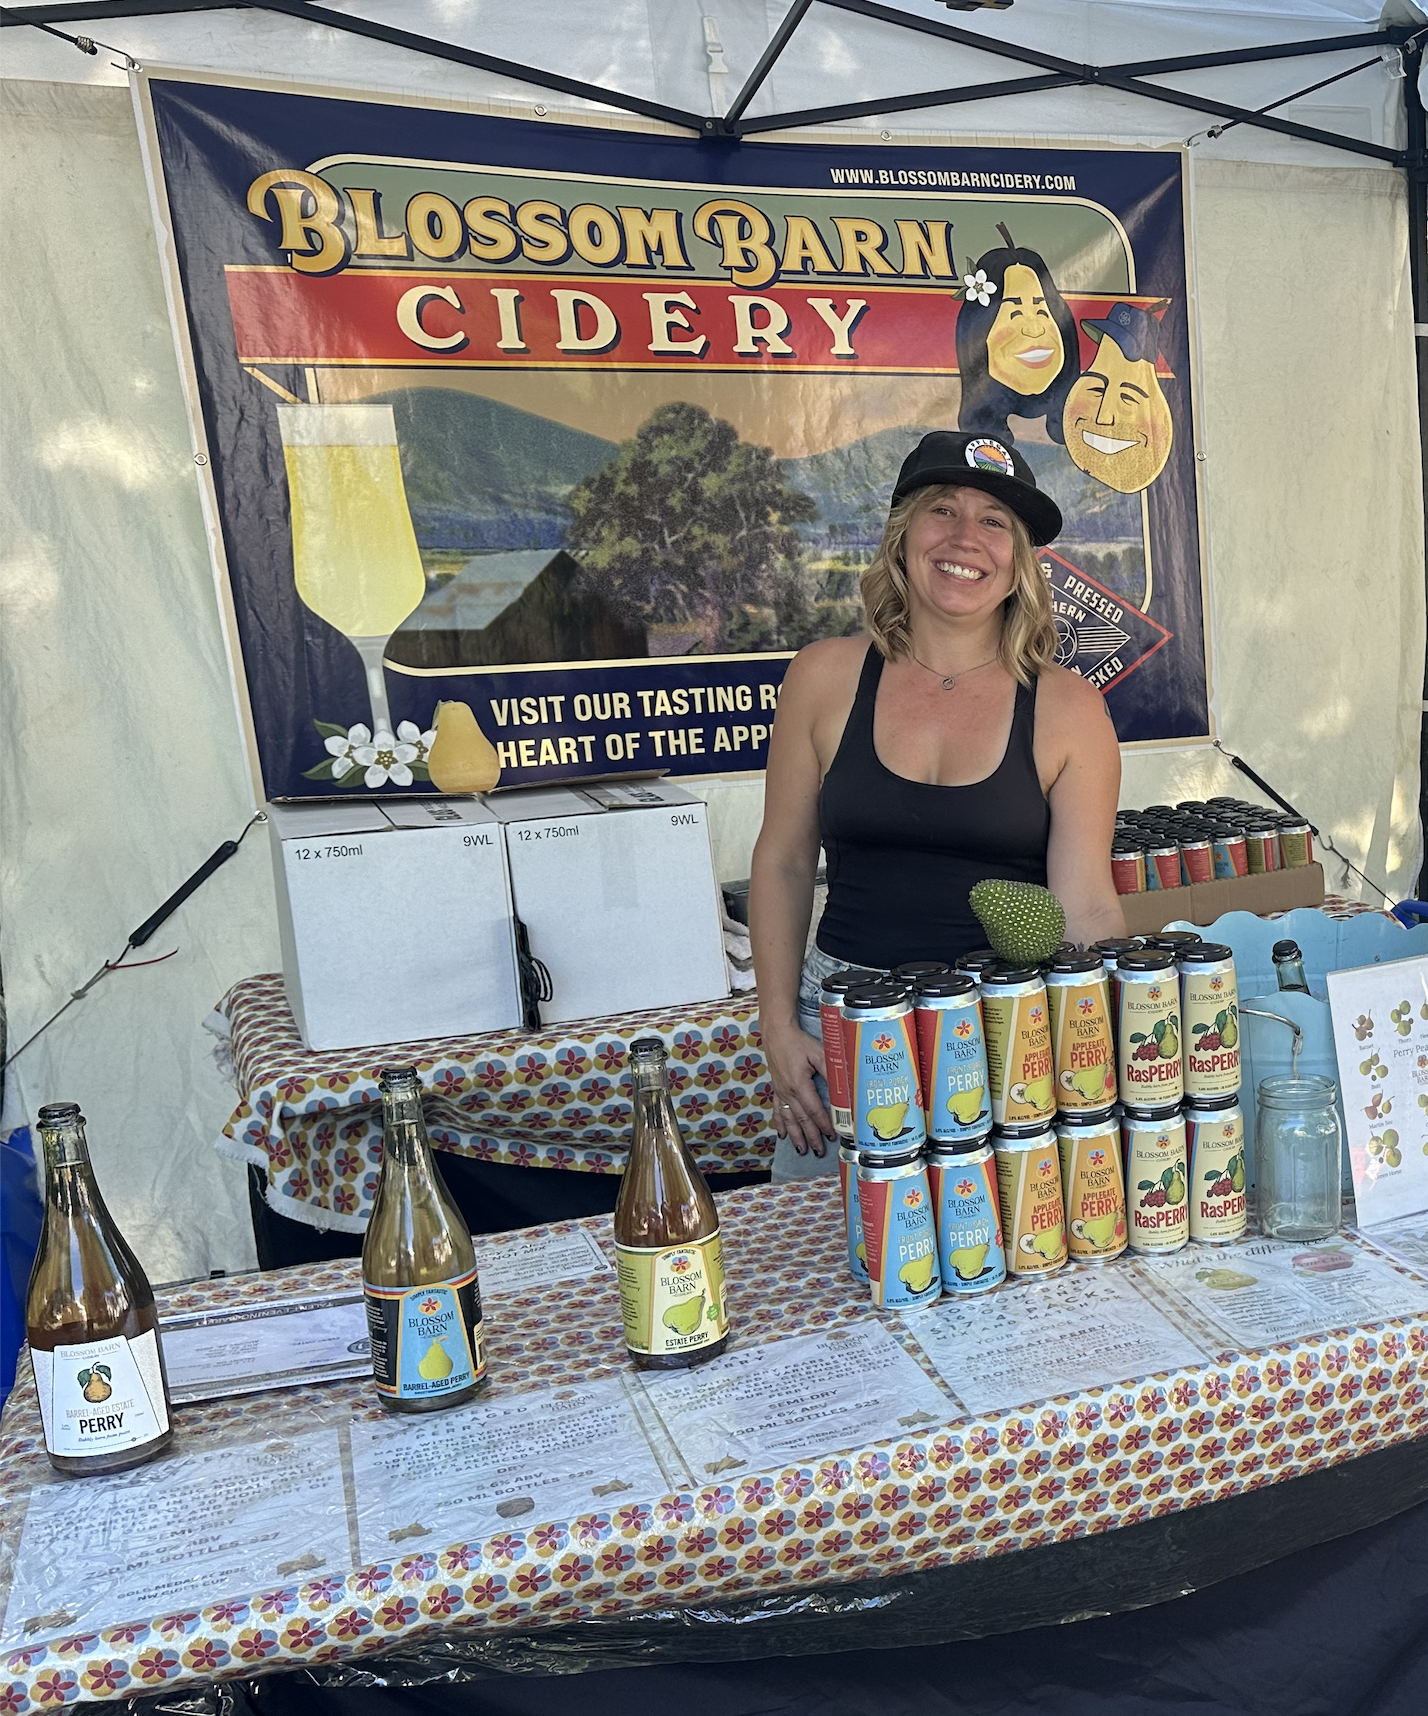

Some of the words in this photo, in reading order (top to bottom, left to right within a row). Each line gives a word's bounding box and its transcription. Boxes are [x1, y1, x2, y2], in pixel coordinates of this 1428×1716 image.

[831, 168, 1077, 191] WWW.BLOSSOMBARNCIDERY.COM
[247, 169, 694, 278] BLOSSOM
[692, 199, 955, 290] BARN
[396, 285, 868, 357] CIDERY
[1063, 574, 1124, 624] PRESSED
[1051, 600, 1087, 623] HERN
[1087, 656, 1124, 689] CKED
[490, 695, 566, 727] VISIT
[573, 691, 632, 722] OUR
[636, 685, 753, 717] TASTING
[497, 735, 597, 769] HEART
[604, 732, 642, 761] OF
[648, 728, 706, 757] THE
[671, 814, 699, 827] 9WL
[462, 833, 494, 848] 9WL
[517, 830, 533, 841] 12
[534, 832, 543, 840] x
[543, 825, 580, 839] 750ml
[294, 847, 311, 861] 12
[314, 851, 323, 860] x
[324, 844, 364, 859] 750ml
[1190, 992, 1223, 1001] BLOSSOM
[1127, 1001, 1161, 1010] BLOSSOM
[1077, 1027, 1100, 1037] BARN
[1029, 1035, 1048, 1047] BARN
[1072, 1038, 1106, 1051] APPLEGATE
[865, 1051, 905, 1065] BLOSSOM
[954, 1047, 977, 1059] BARN
[1070, 1046, 1108, 1068] PERRY
[1393, 1048, 1414, 1058] Perry
[1415, 1045, 1428, 1053] Pea
[873, 1062, 900, 1072] BARN
[948, 1068, 985, 1092] PERRY
[867, 1084, 909, 1106] PERRY
[1203, 1140, 1233, 1149] BLOSSOM
[1136, 1150, 1169, 1158] BLOSSOM
[1080, 1166, 1115, 1179] BLOSSOM
[1087, 1176, 1111, 1187] BARN
[1037, 1186, 1057, 1199] BARN
[1083, 1187, 1116, 1201] APPLEGATE
[948, 1194, 986, 1208] BLOSSOM
[1081, 1195, 1118, 1217] PERRY
[955, 1205, 981, 1217] BARN
[905, 1214, 927, 1228] BARN
[949, 1226, 990, 1248] PERRY
[900, 1234, 935, 1262] PERRY
[660, 1270, 702, 1287] BLOSSOM
[669, 1282, 697, 1295] BARN
[408, 1311, 455, 1328] BLOSSOM
[417, 1322, 448, 1336] BARN
[1059, 1323, 1106, 1340] PERRY
[665, 1335, 689, 1347] ESTATE
[689, 1331, 709, 1343] PERRY
[1094, 1338, 1142, 1354] PERRY
[60, 1348, 97, 1358] BLOSSOM
[403, 1378, 450, 1391] BARREL-AGED
[450, 1371, 471, 1384] PERRY
[768, 1389, 838, 1409] SEMI-DRY
[65, 1404, 111, 1418] BARREL-AGED
[112, 1399, 135, 1413] ESTATE
[784, 1406, 849, 1425] BOTTLES
[801, 1402, 829, 1413] ABV
[79, 1412, 124, 1435] PERRY
[496, 1463, 527, 1475] DRY
[514, 1472, 544, 1483] ABV
[467, 1492, 492, 1502] ML
[494, 1477, 561, 1496] BOTTLES
